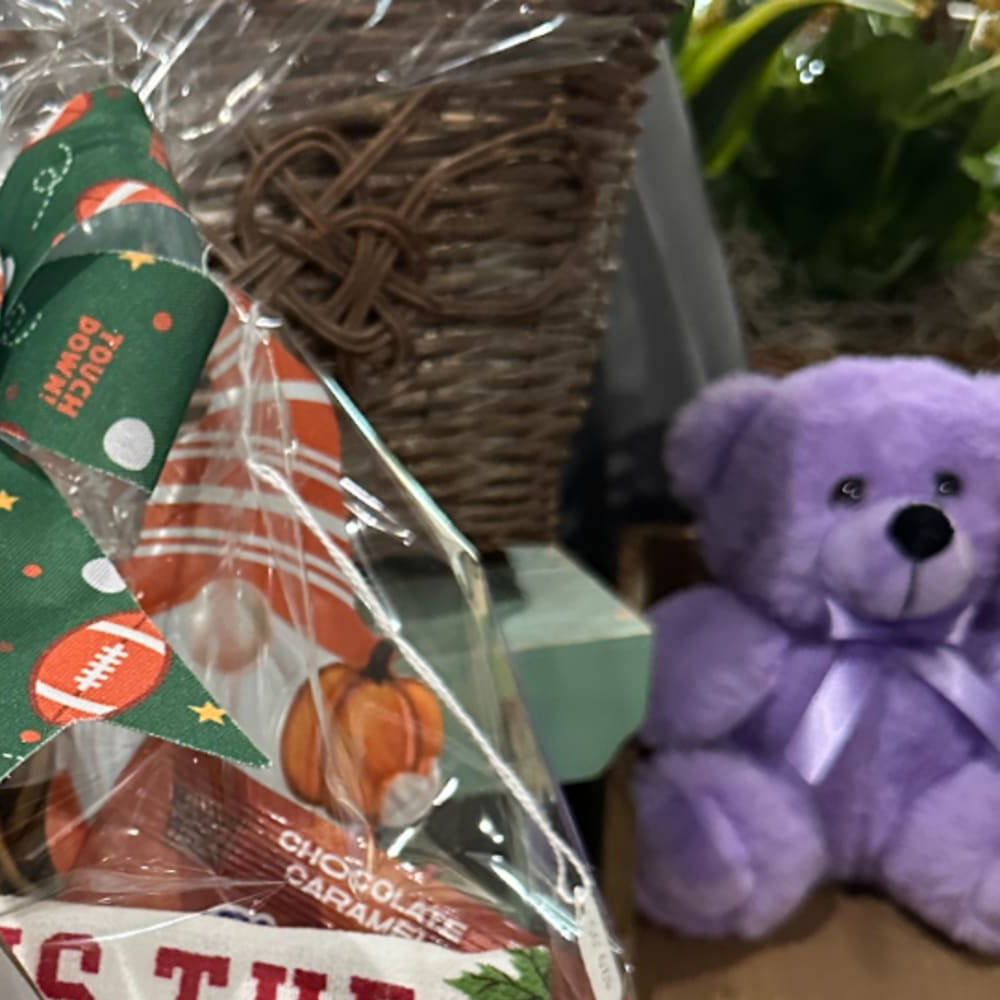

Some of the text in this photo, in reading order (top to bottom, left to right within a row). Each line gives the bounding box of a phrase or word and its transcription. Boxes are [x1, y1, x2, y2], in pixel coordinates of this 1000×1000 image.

[39, 314, 102, 406] DOWN!
[57, 330, 124, 419] TOUCH
[279, 829, 470, 944] CHOCOLATE
